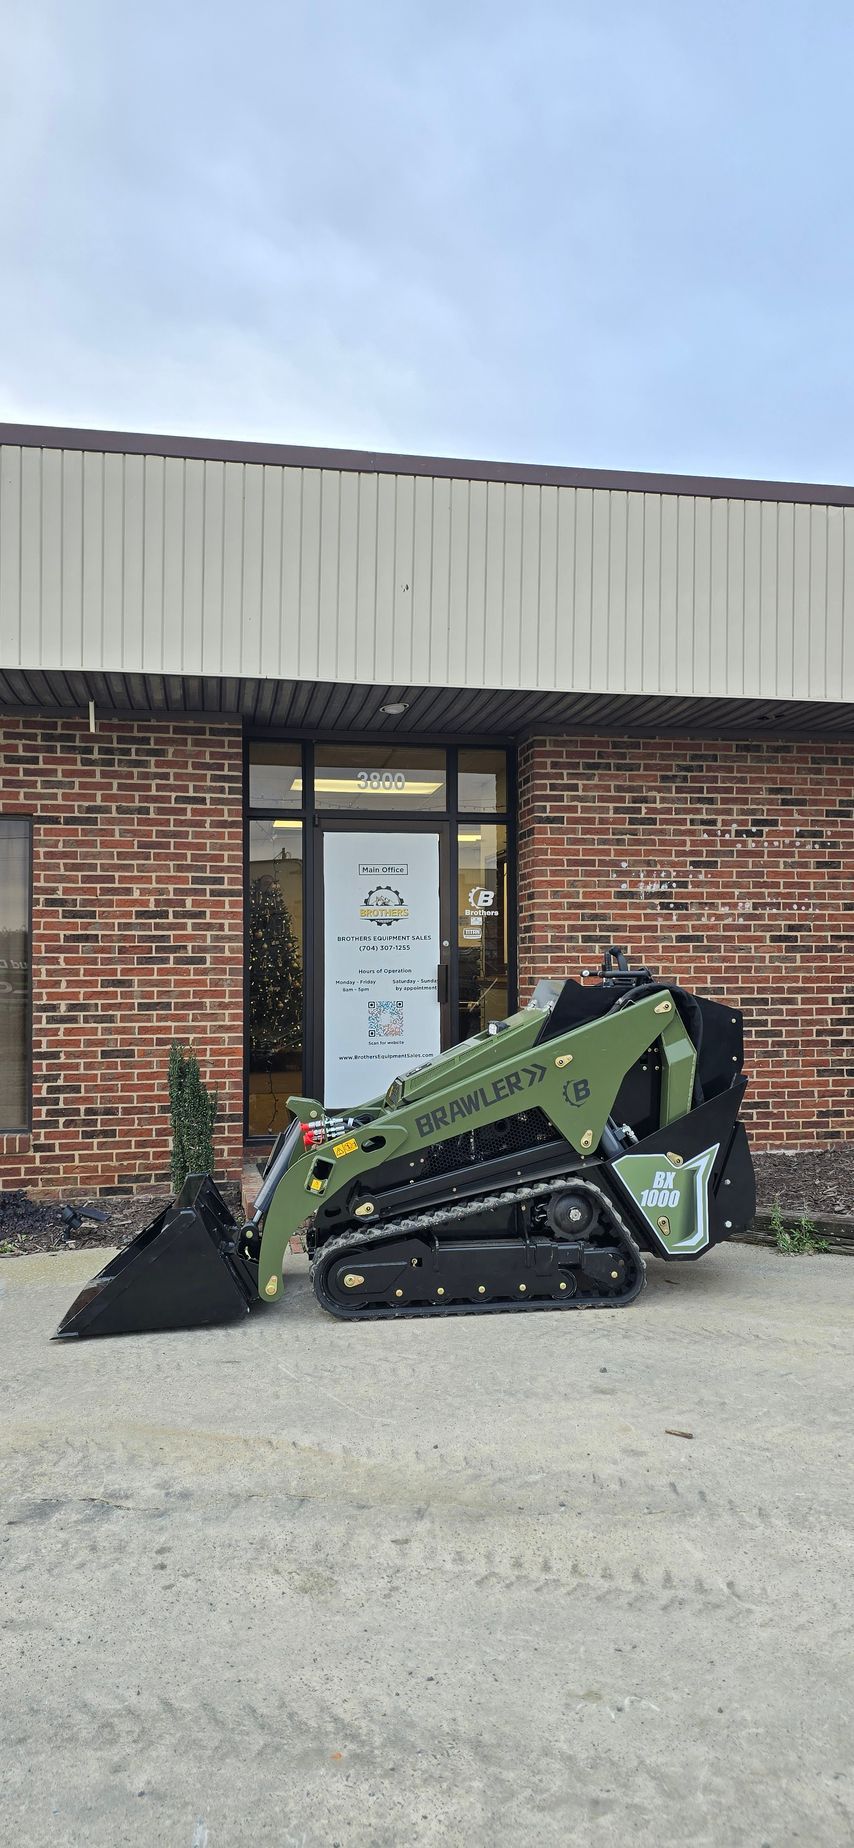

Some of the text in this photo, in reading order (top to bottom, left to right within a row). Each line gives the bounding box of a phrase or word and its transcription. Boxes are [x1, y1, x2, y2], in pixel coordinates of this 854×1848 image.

[357, 771, 406, 790] 3800
[360, 908, 409, 918] BROTHERS
[414, 1071, 525, 1138] BRAWLER
[652, 1171, 677, 1189] BX
[640, 1189, 681, 1208] 1000
